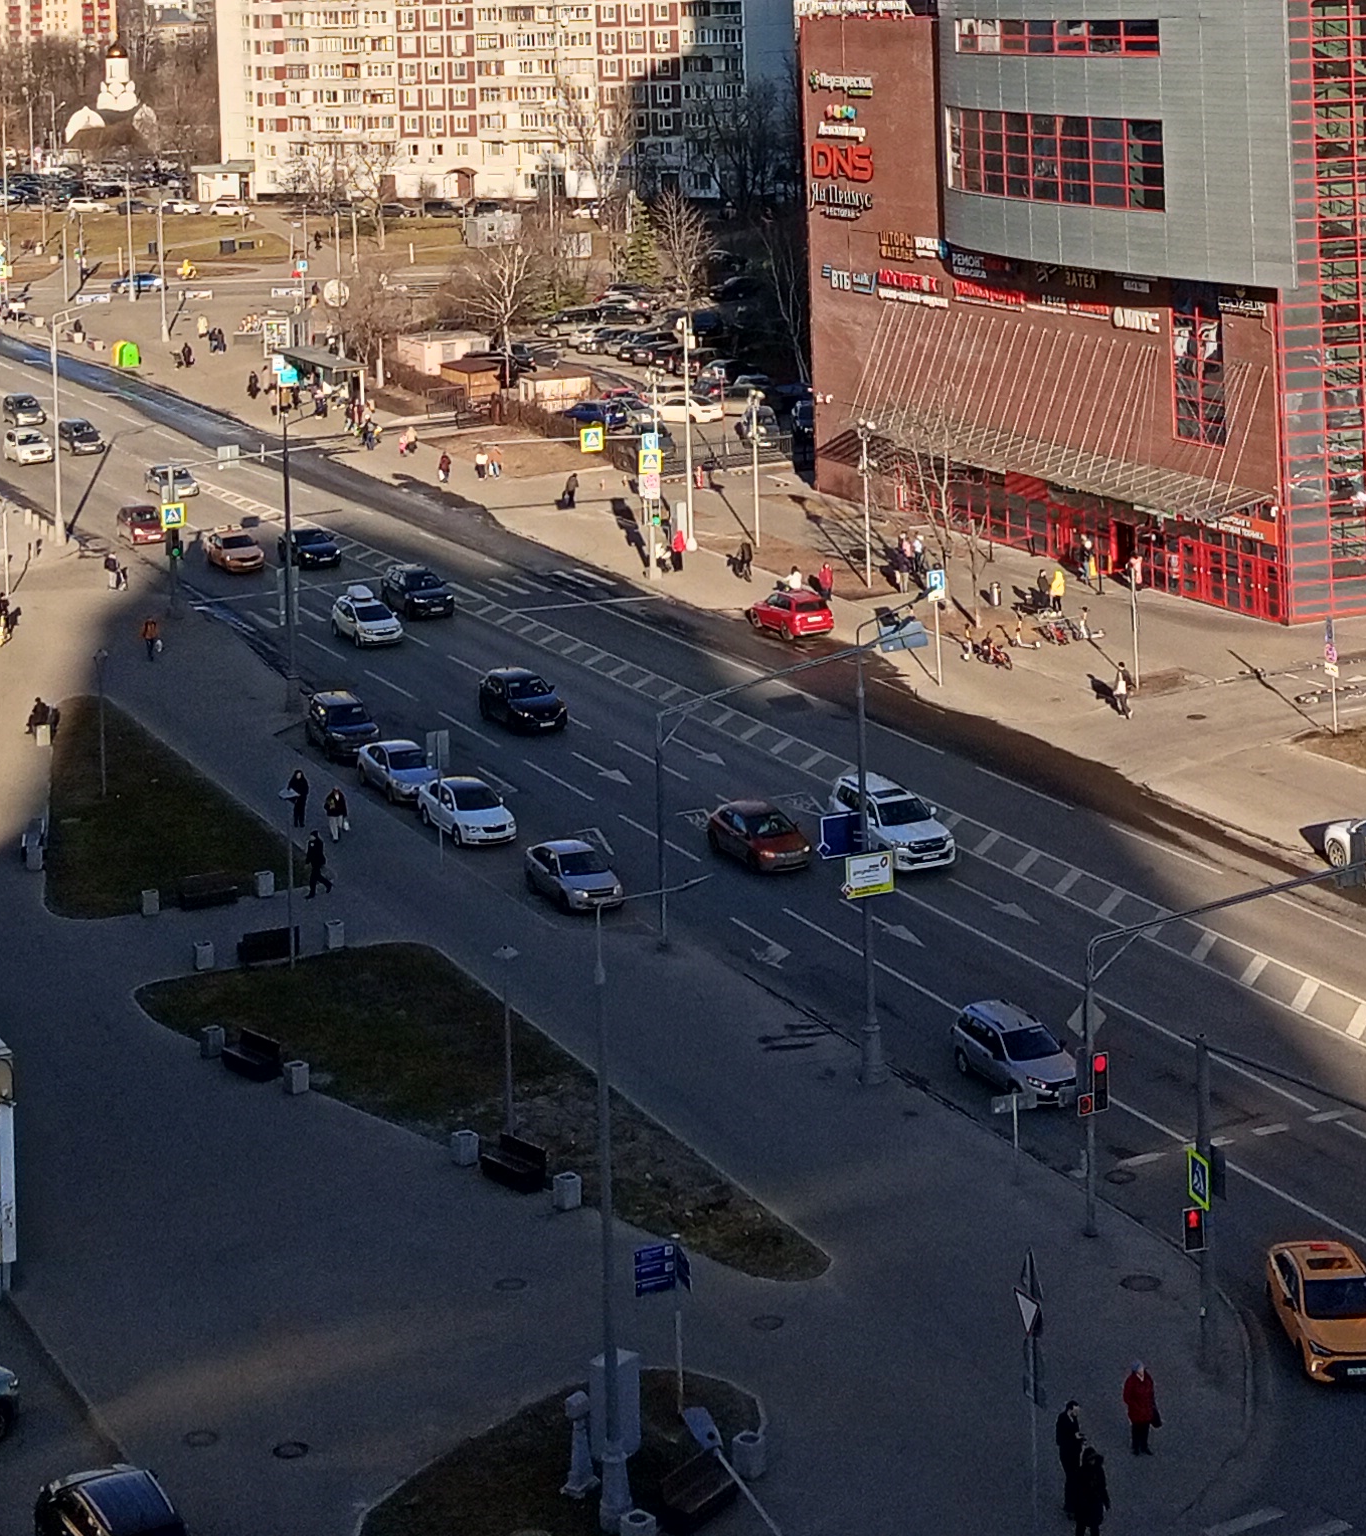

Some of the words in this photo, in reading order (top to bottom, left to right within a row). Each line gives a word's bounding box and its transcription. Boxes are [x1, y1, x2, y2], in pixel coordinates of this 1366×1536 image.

[812, 143, 873, 181] DNS
[811, 182, 826, 209] Ян
[829, 184, 872, 210] Примус
[879, 230, 914, 248] ШТОРЫ
[952, 252, 985, 268] РЕМОНТ
[831, 269, 851, 291] ВТБ
[1065, 271, 1096, 289] ЗАТЕЯ
